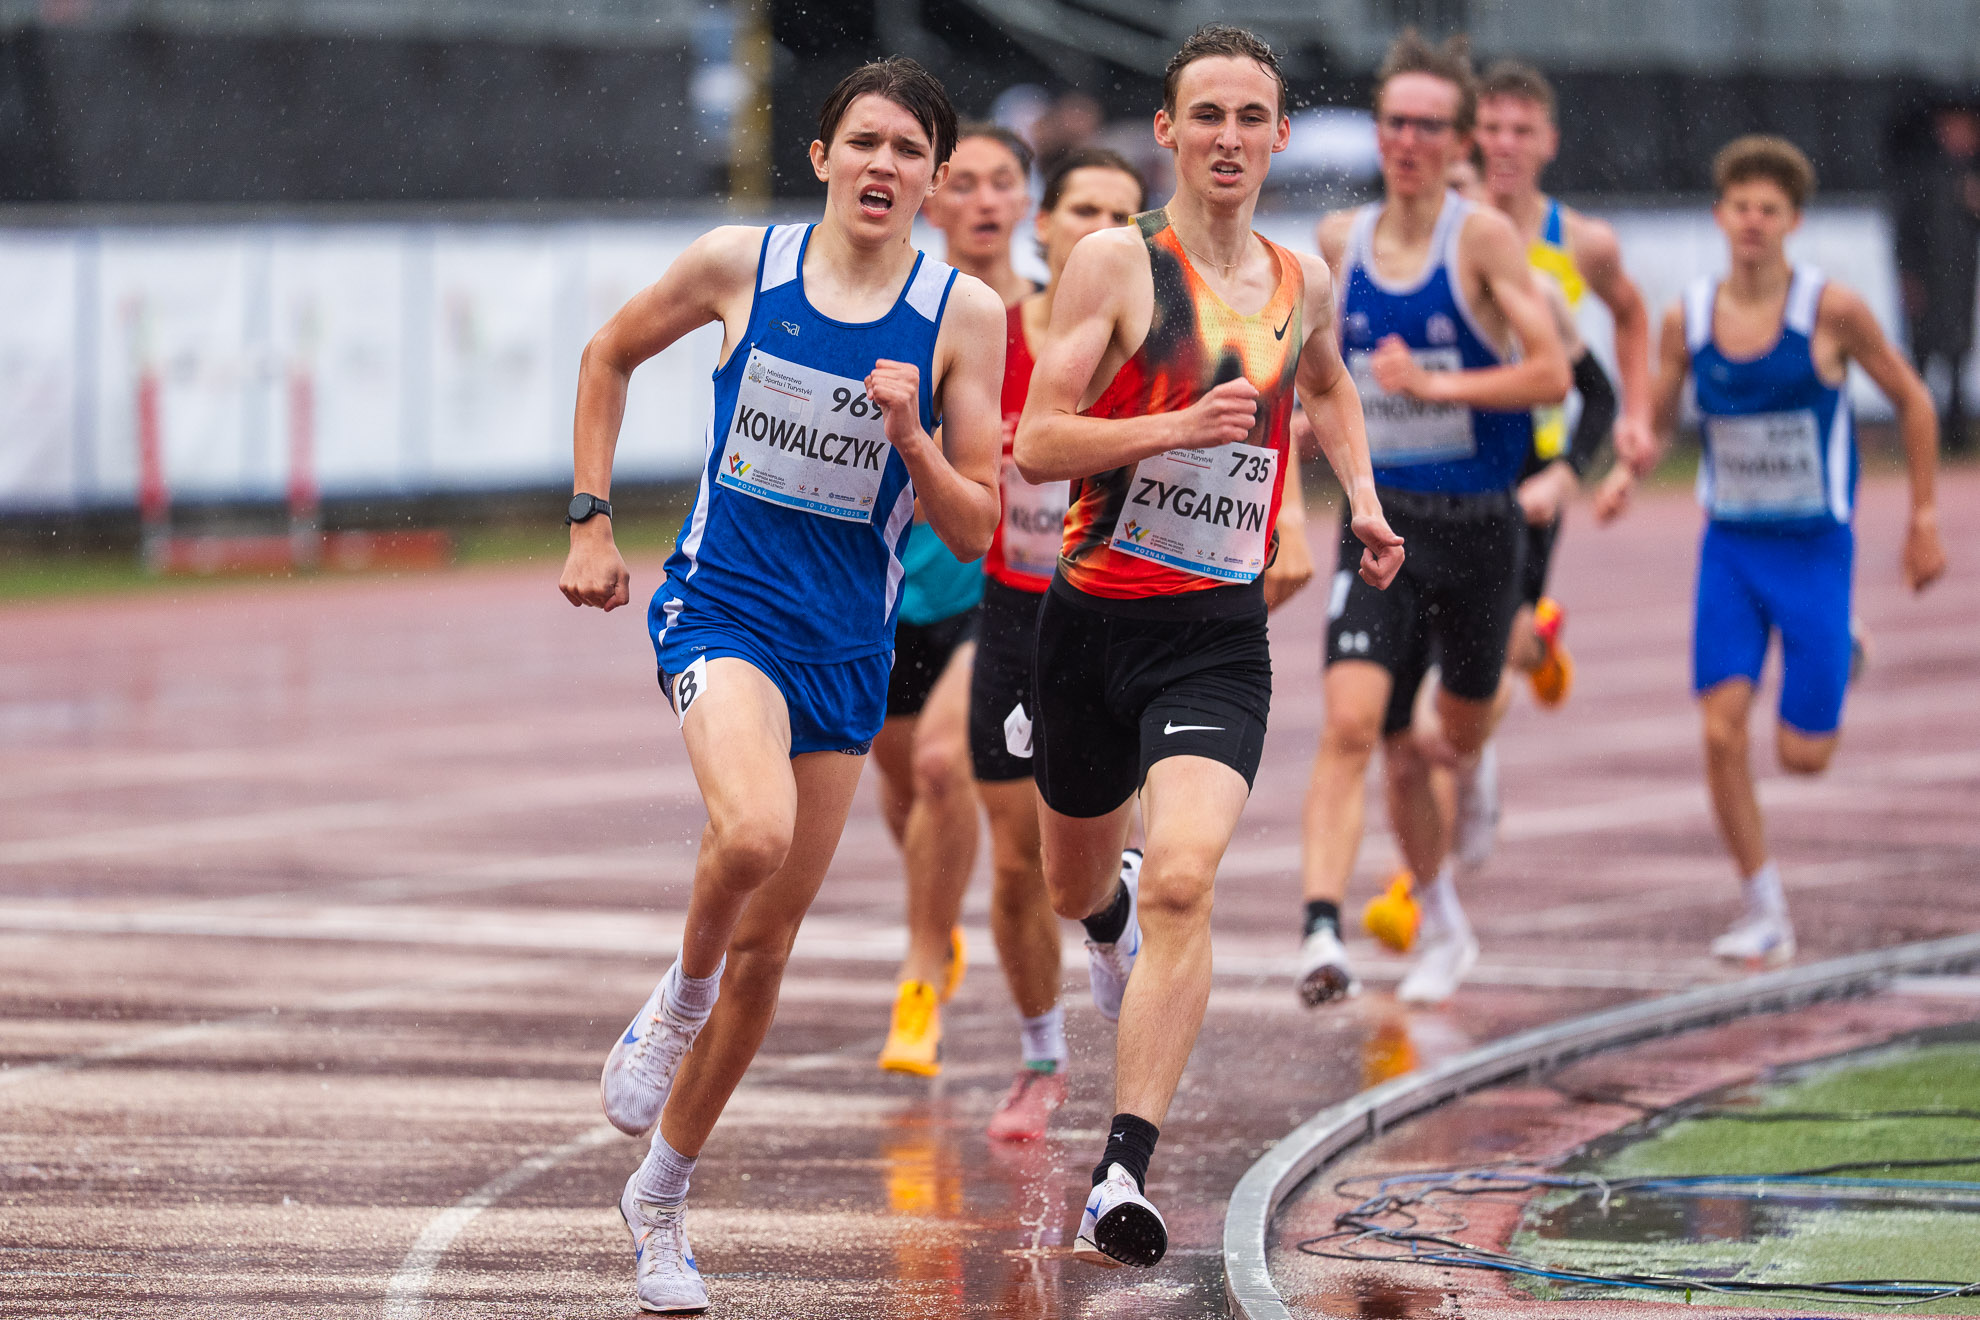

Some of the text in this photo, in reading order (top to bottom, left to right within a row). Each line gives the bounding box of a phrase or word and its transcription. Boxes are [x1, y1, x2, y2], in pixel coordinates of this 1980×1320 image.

[765, 375, 783, 387] Sportu
[787, 382, 813, 396] Turystyki
[766, 369, 802, 385] Ministerstwo
[735, 405, 886, 471] KOWALCZYK
[1228, 451, 1271, 484] 735
[737, 481, 767, 496] POZNAŃ
[1131, 477, 1266, 533] ZYGARYN
[1134, 546, 1166, 561] POZNAŃ
[679, 670, 698, 713] 8
